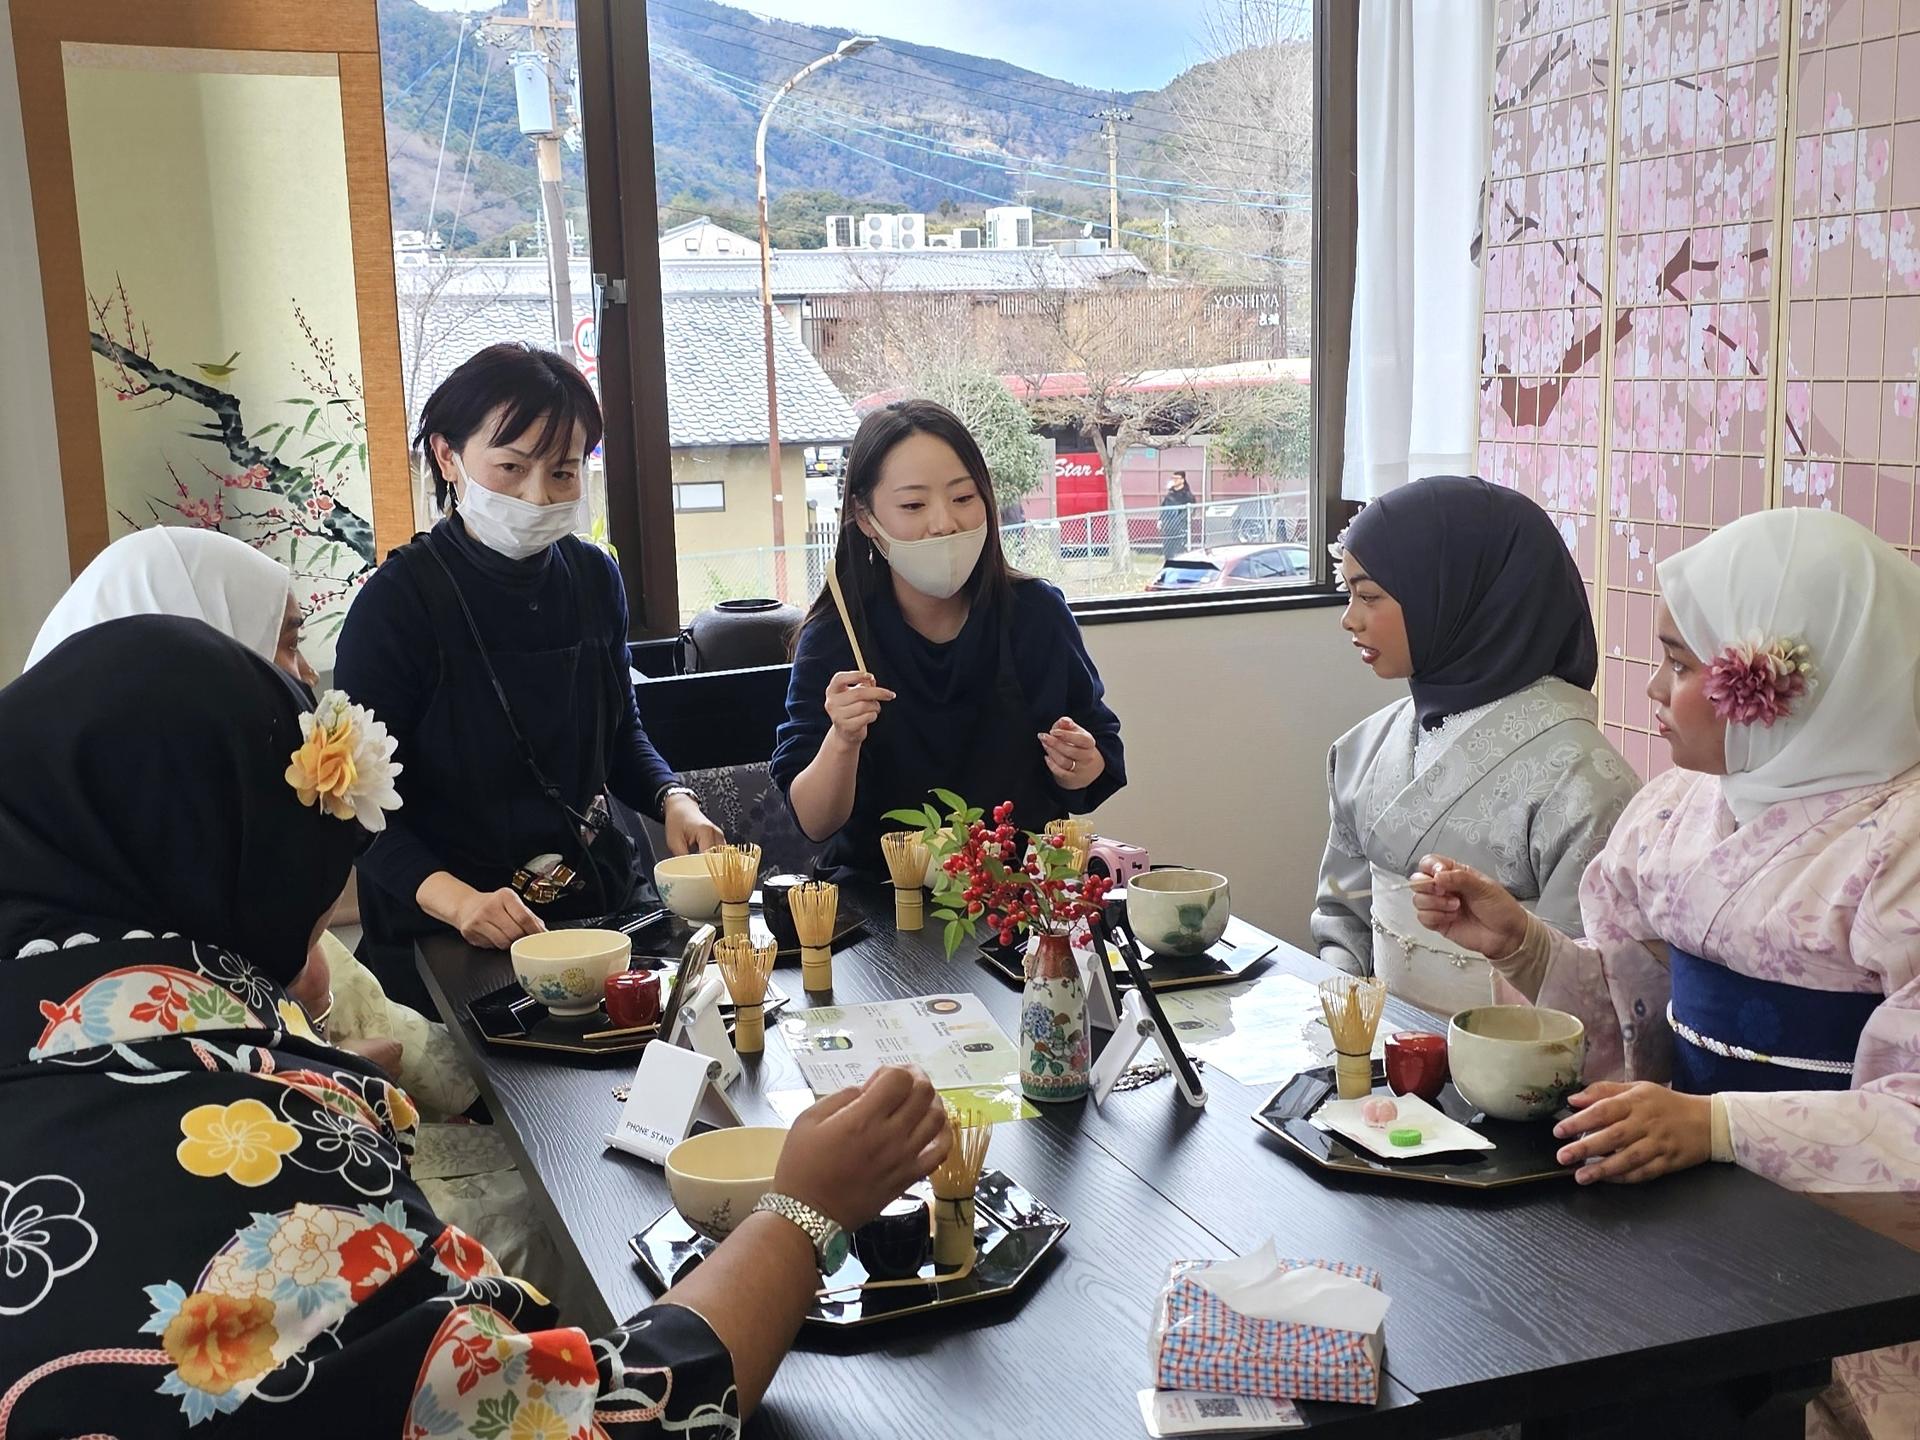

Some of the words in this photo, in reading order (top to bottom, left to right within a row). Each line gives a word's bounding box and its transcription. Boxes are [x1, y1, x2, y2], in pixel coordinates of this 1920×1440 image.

[1213, 293, 1280, 309] YOSHIYA
[1055, 458, 1092, 477] Star
[626, 1121, 649, 1136] PHONE
[651, 1131, 674, 1145] STAND
